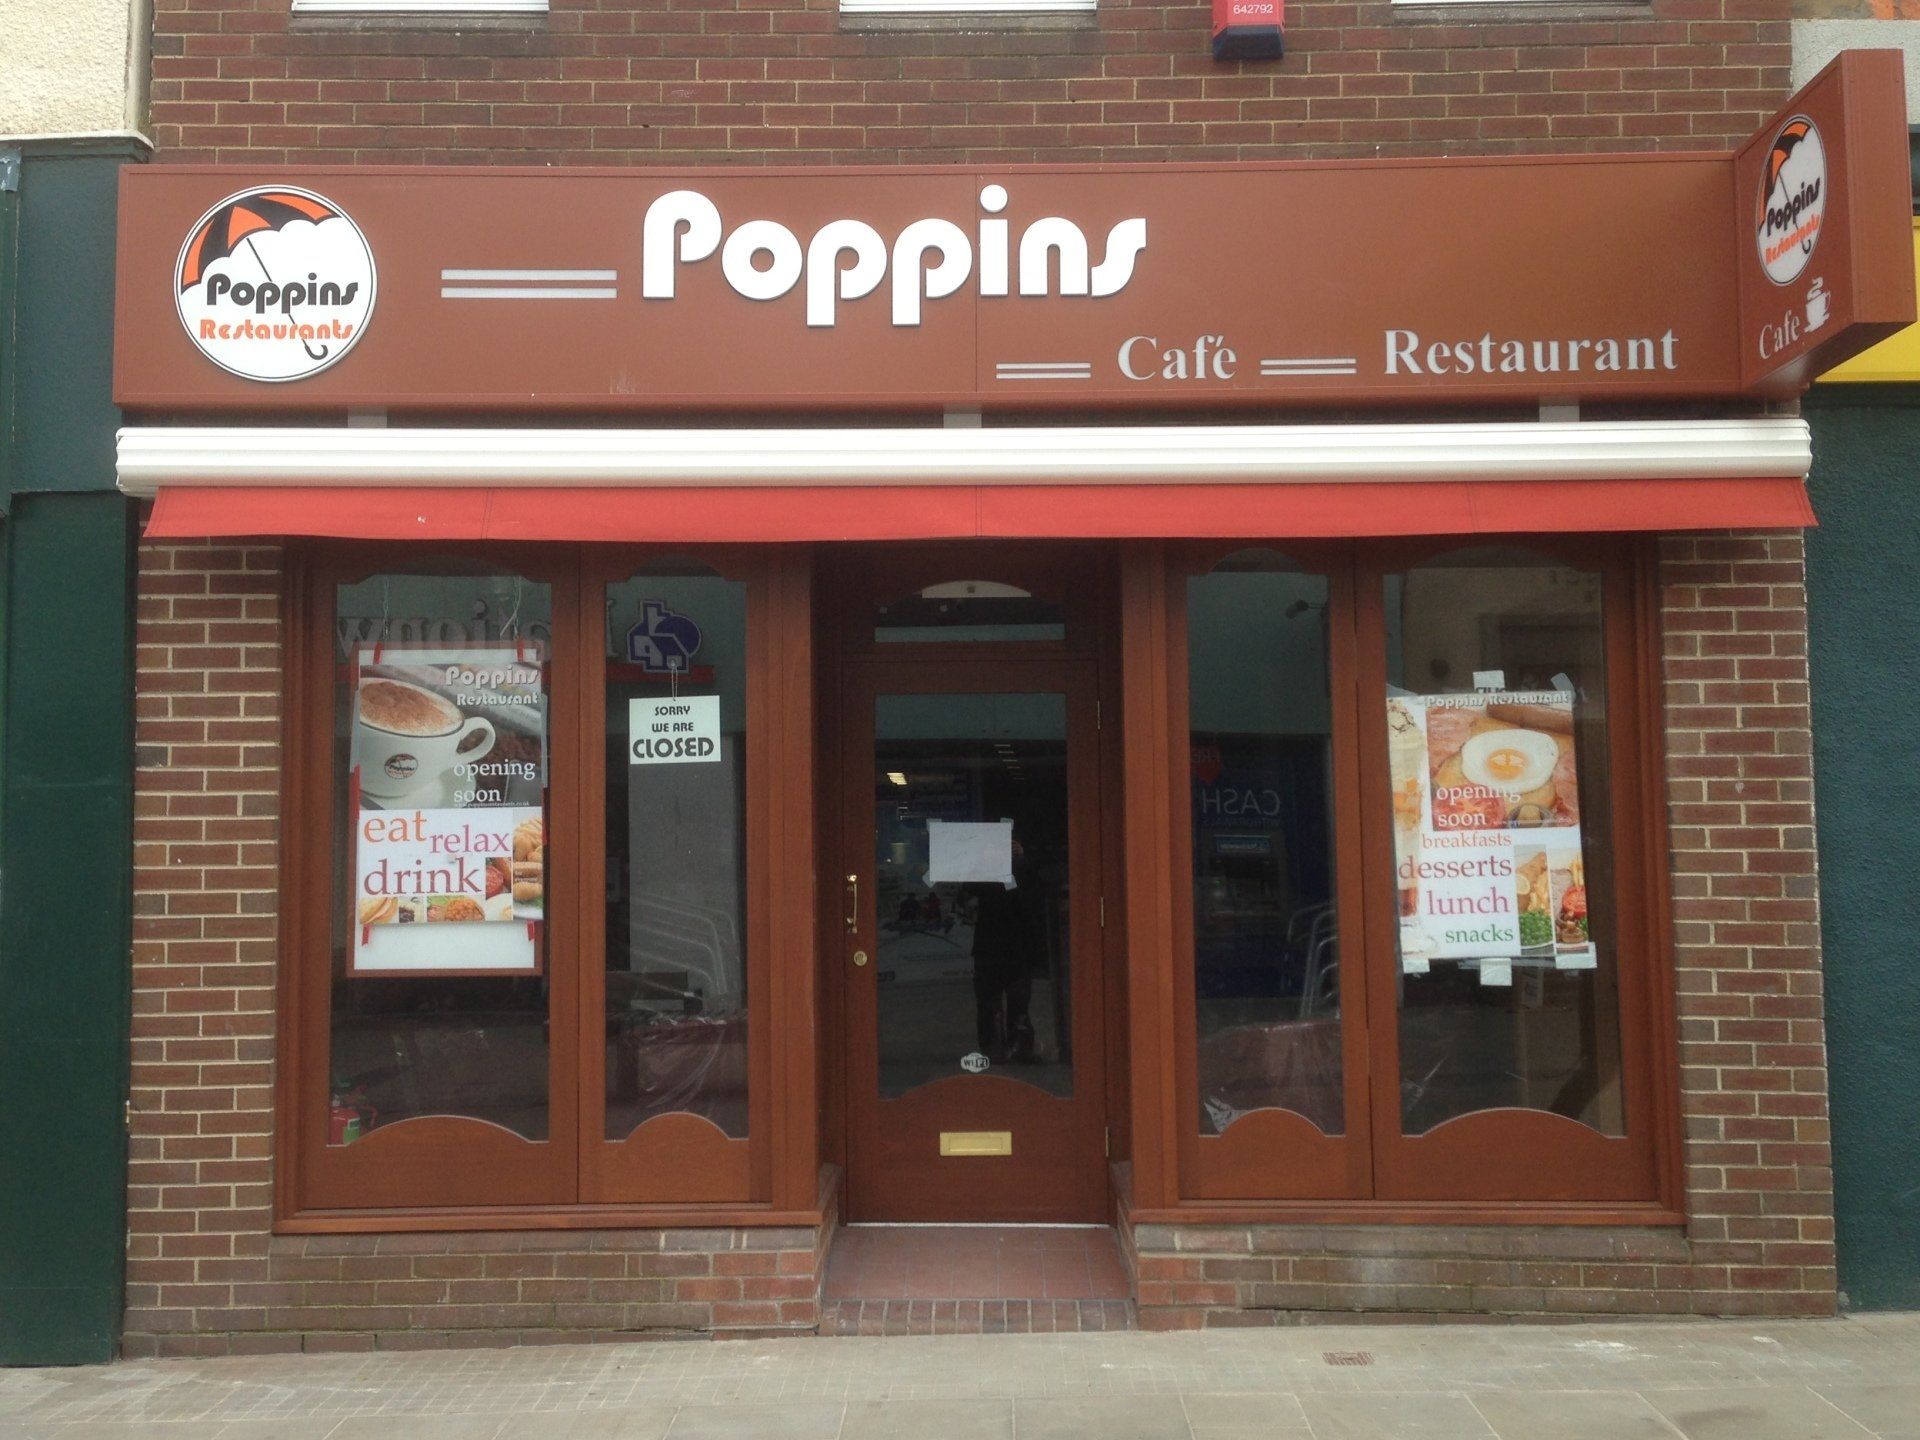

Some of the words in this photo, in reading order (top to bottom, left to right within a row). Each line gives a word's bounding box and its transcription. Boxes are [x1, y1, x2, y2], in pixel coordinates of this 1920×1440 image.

[1232, 4, 1274, 14] 642792
[1766, 176, 1821, 237] Poppins
[1764, 213, 1820, 266] Restaurants
[643, 184, 1147, 328] Poppins
[207, 272, 359, 314] Poppins
[200, 319, 354, 341] Restaurants
[1758, 309, 1801, 360] Cafe
[1117, 335, 1237, 380] Café
[1384, 328, 1679, 375] Restaurant
[445, 665, 540, 690] Poppins
[456, 691, 539, 707] Restaurant
[1426, 694, 1486, 711] Poppins
[1488, 691, 1570, 707] Restaurant
[654, 705, 691, 717] SORRY
[651, 722, 669, 733] WE
[672, 722, 695, 733] ARE
[633, 737, 715, 759] CLOSED
[453, 758, 536, 780] opening
[453, 786, 502, 803] soon
[1436, 782, 1521, 802] opening
[363, 810, 428, 843] eat
[1437, 811, 1487, 828] soon
[429, 824, 510, 854] relax
[1422, 832, 1512, 850] breakfasts
[364, 858, 483, 896] drink
[1398, 856, 1513, 881] desserts
[1426, 886, 1510, 917] lunch
[1445, 923, 1514, 945] snacks
